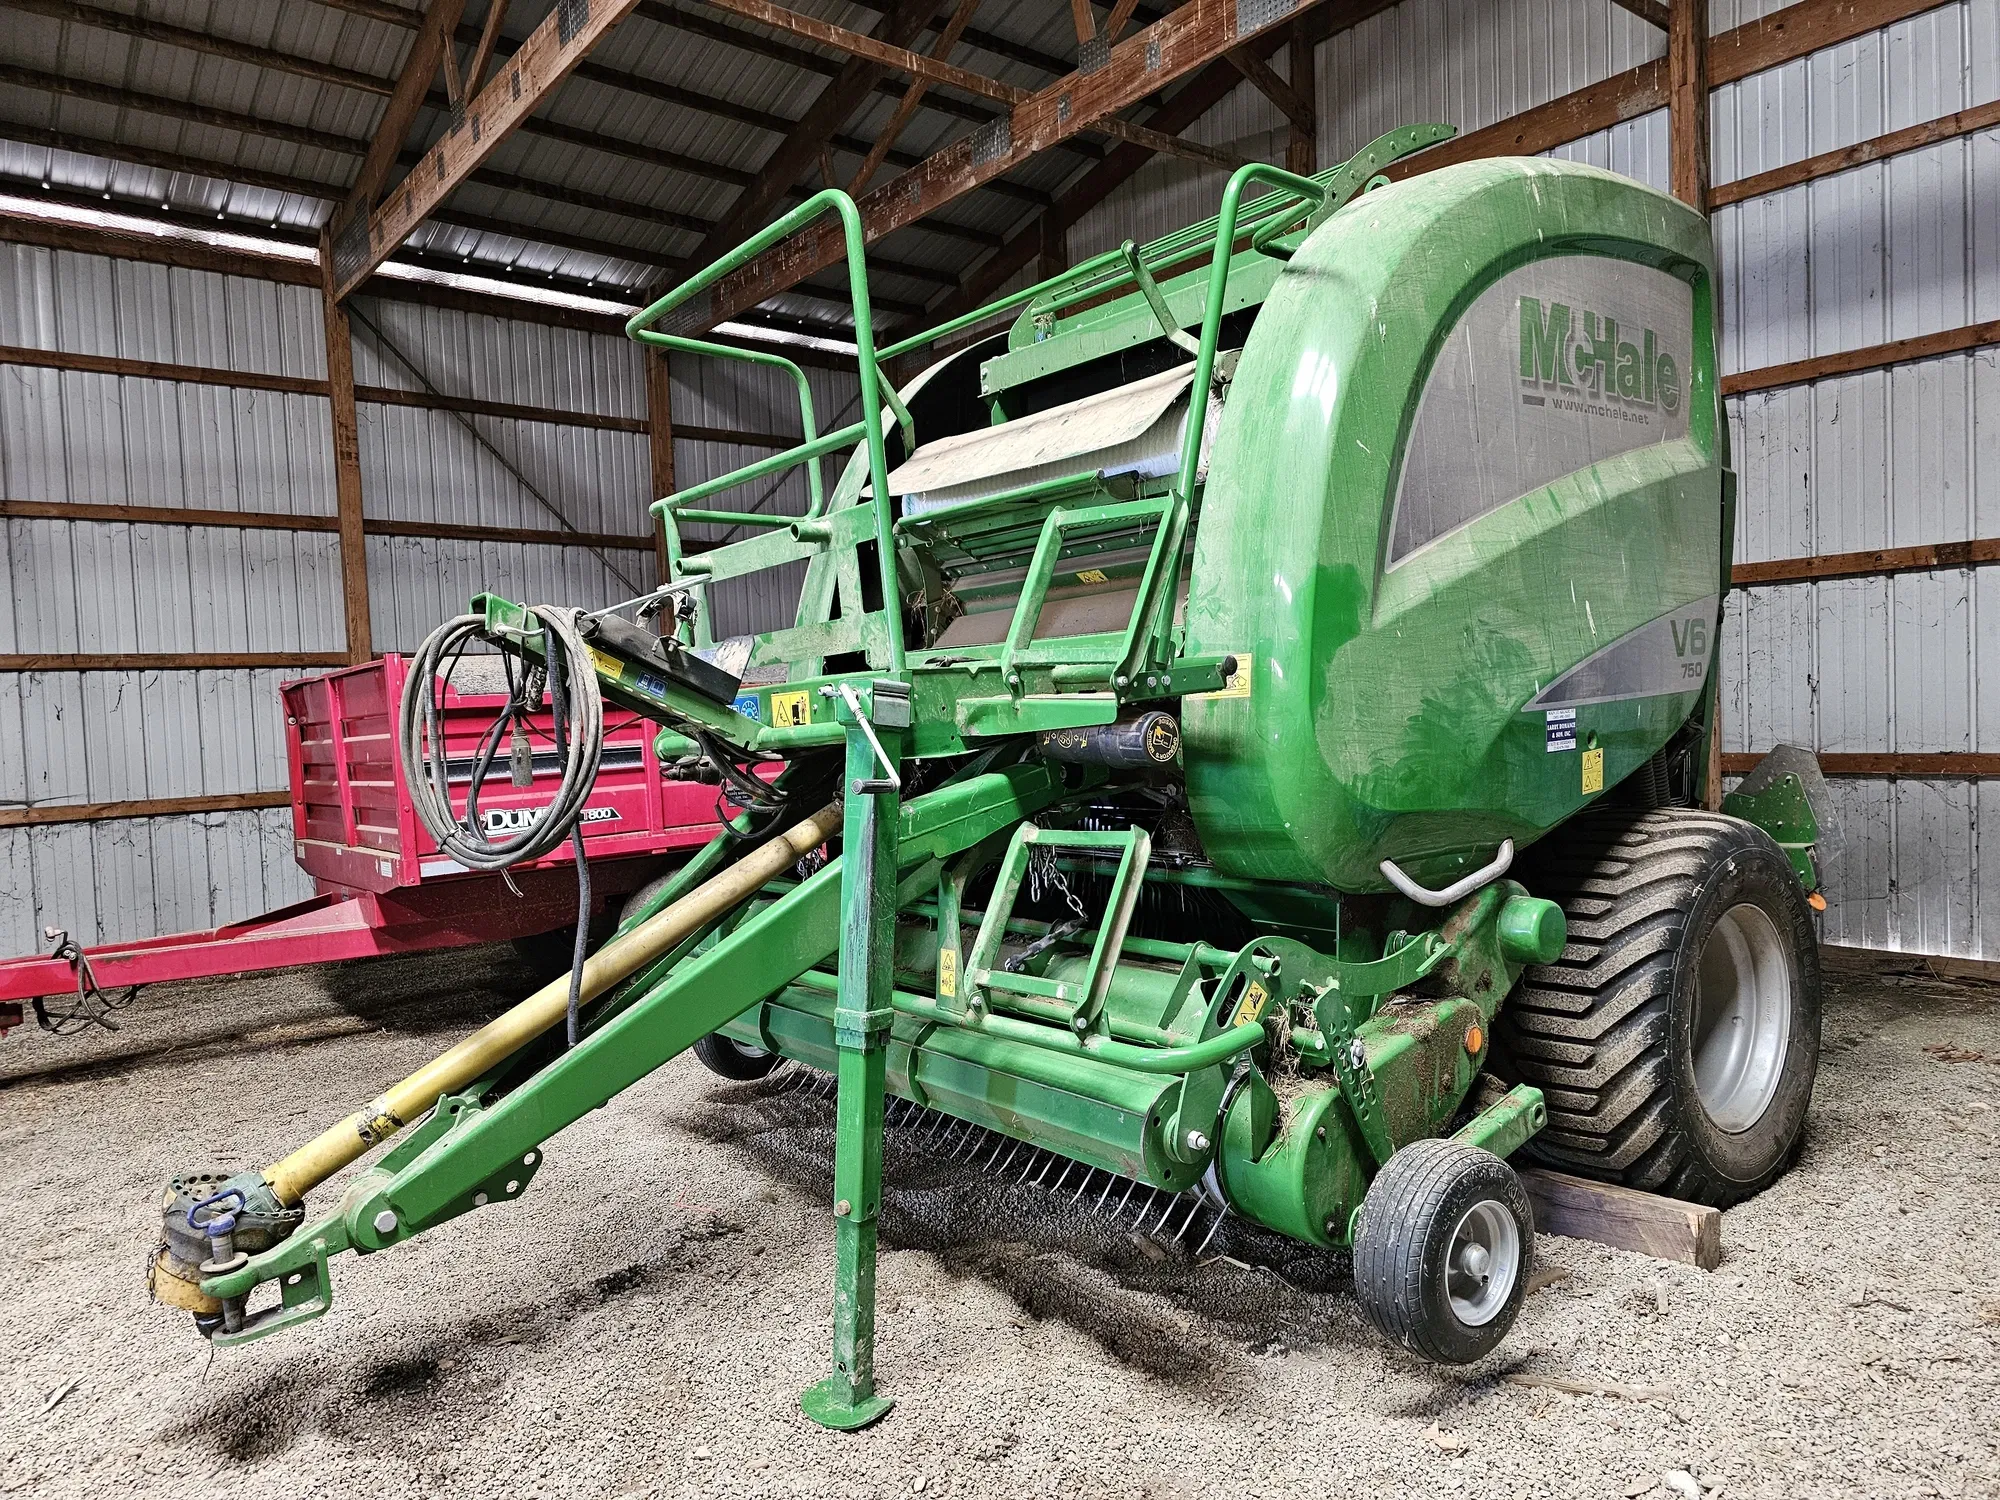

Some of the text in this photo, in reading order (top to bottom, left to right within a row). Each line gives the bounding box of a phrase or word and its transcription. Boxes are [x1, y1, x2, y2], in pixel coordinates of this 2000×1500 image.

[1520, 296, 1680, 411] McHale
[1552, 396, 1650, 426] www.mchale.net
[1670, 617, 1706, 658] V6
[1681, 661, 1703, 679] 750
[487, 808, 549, 830] DUM
[580, 809, 612, 821] T800
